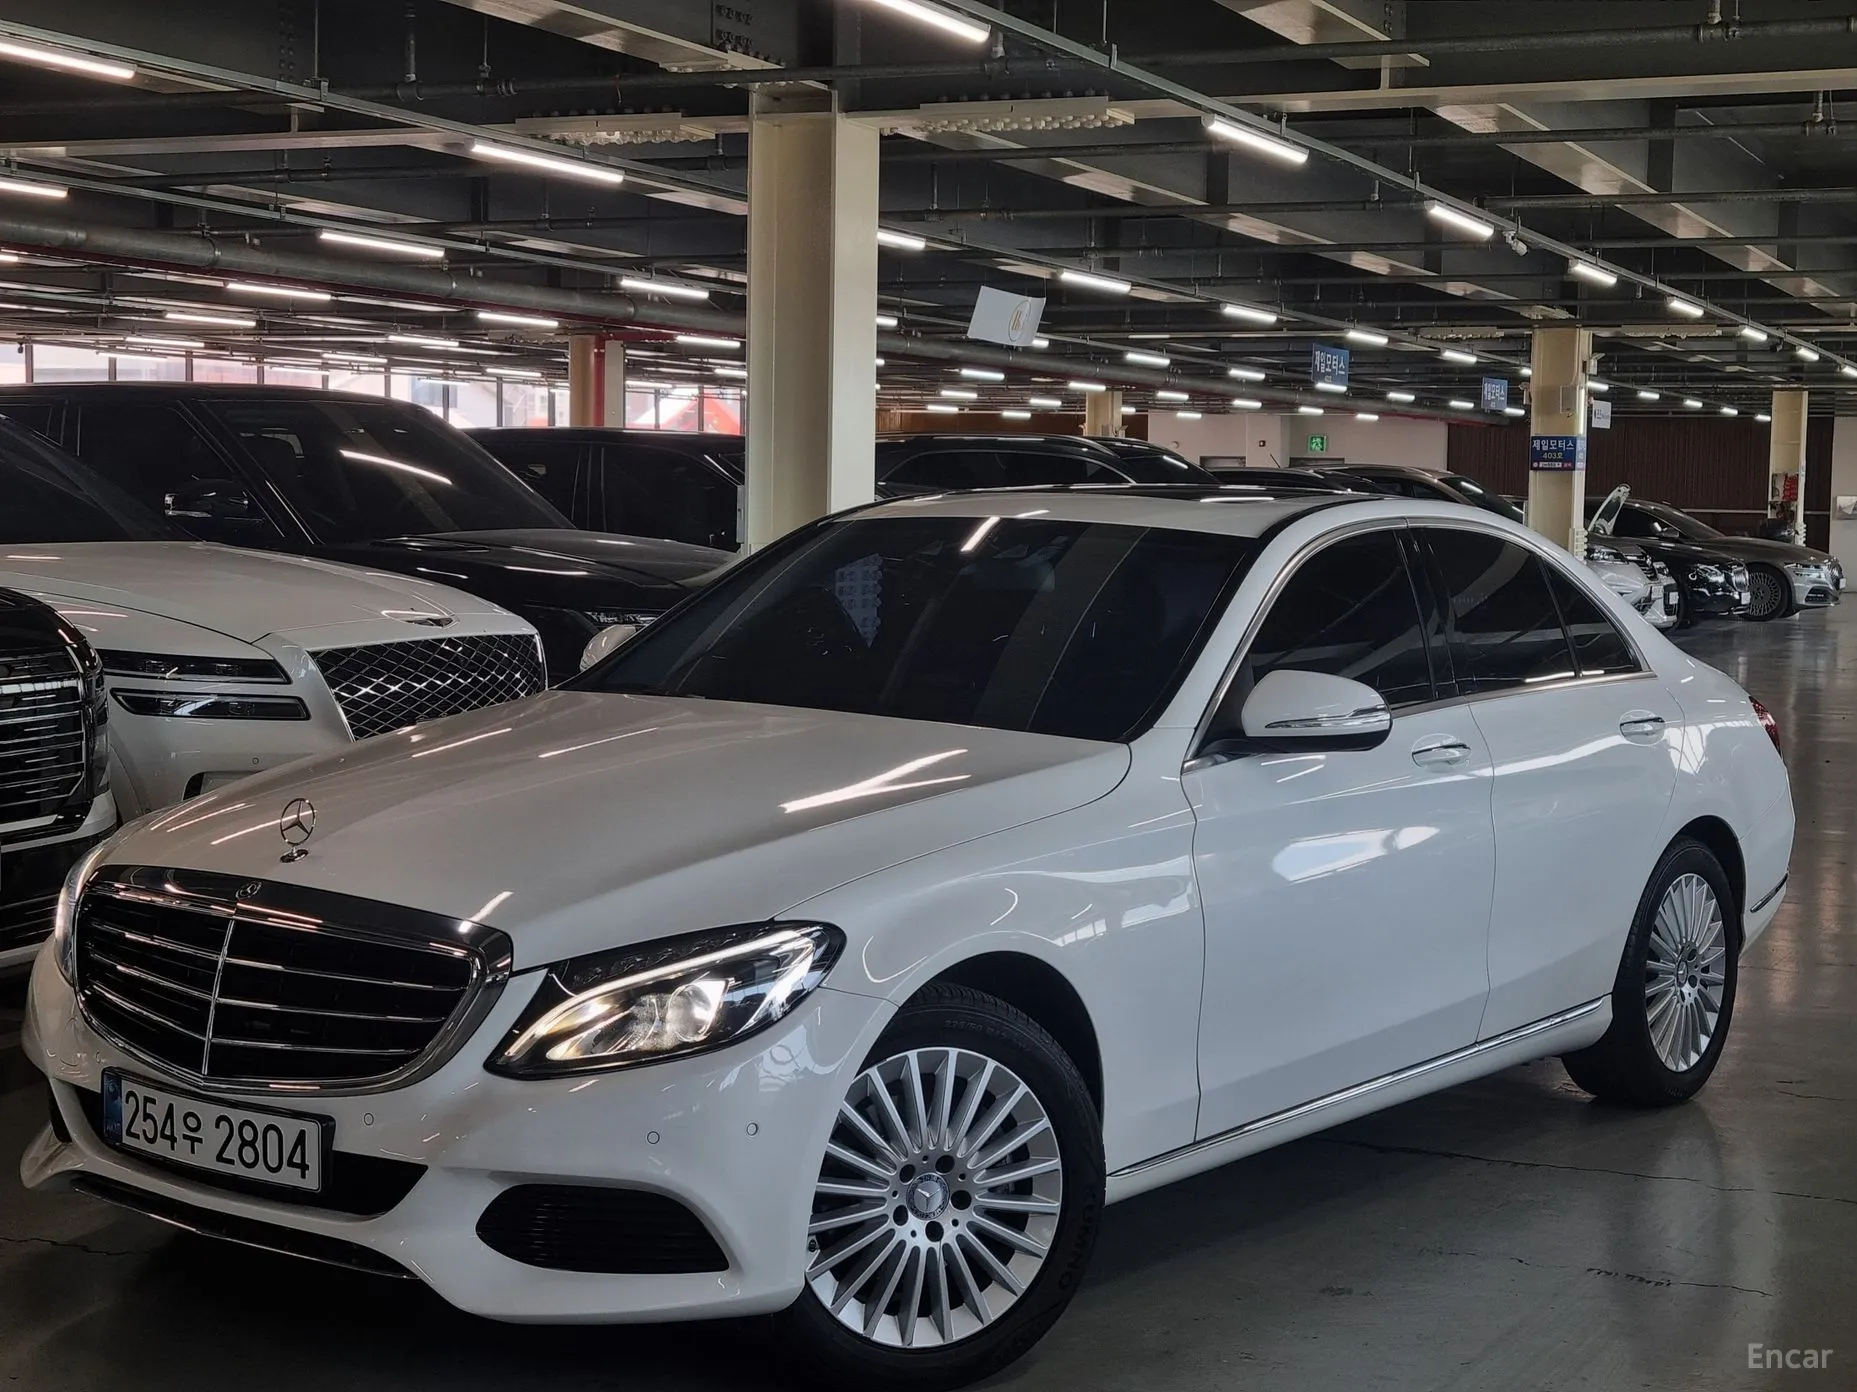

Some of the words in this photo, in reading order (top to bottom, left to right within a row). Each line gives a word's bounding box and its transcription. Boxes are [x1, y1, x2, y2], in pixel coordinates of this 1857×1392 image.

[1314, 350, 1346, 375] 제일모터스
[1532, 439, 1575, 451] 제일모터스
[125, 1089, 204, 1155] 254우
[214, 1114, 310, 1180] 2804
